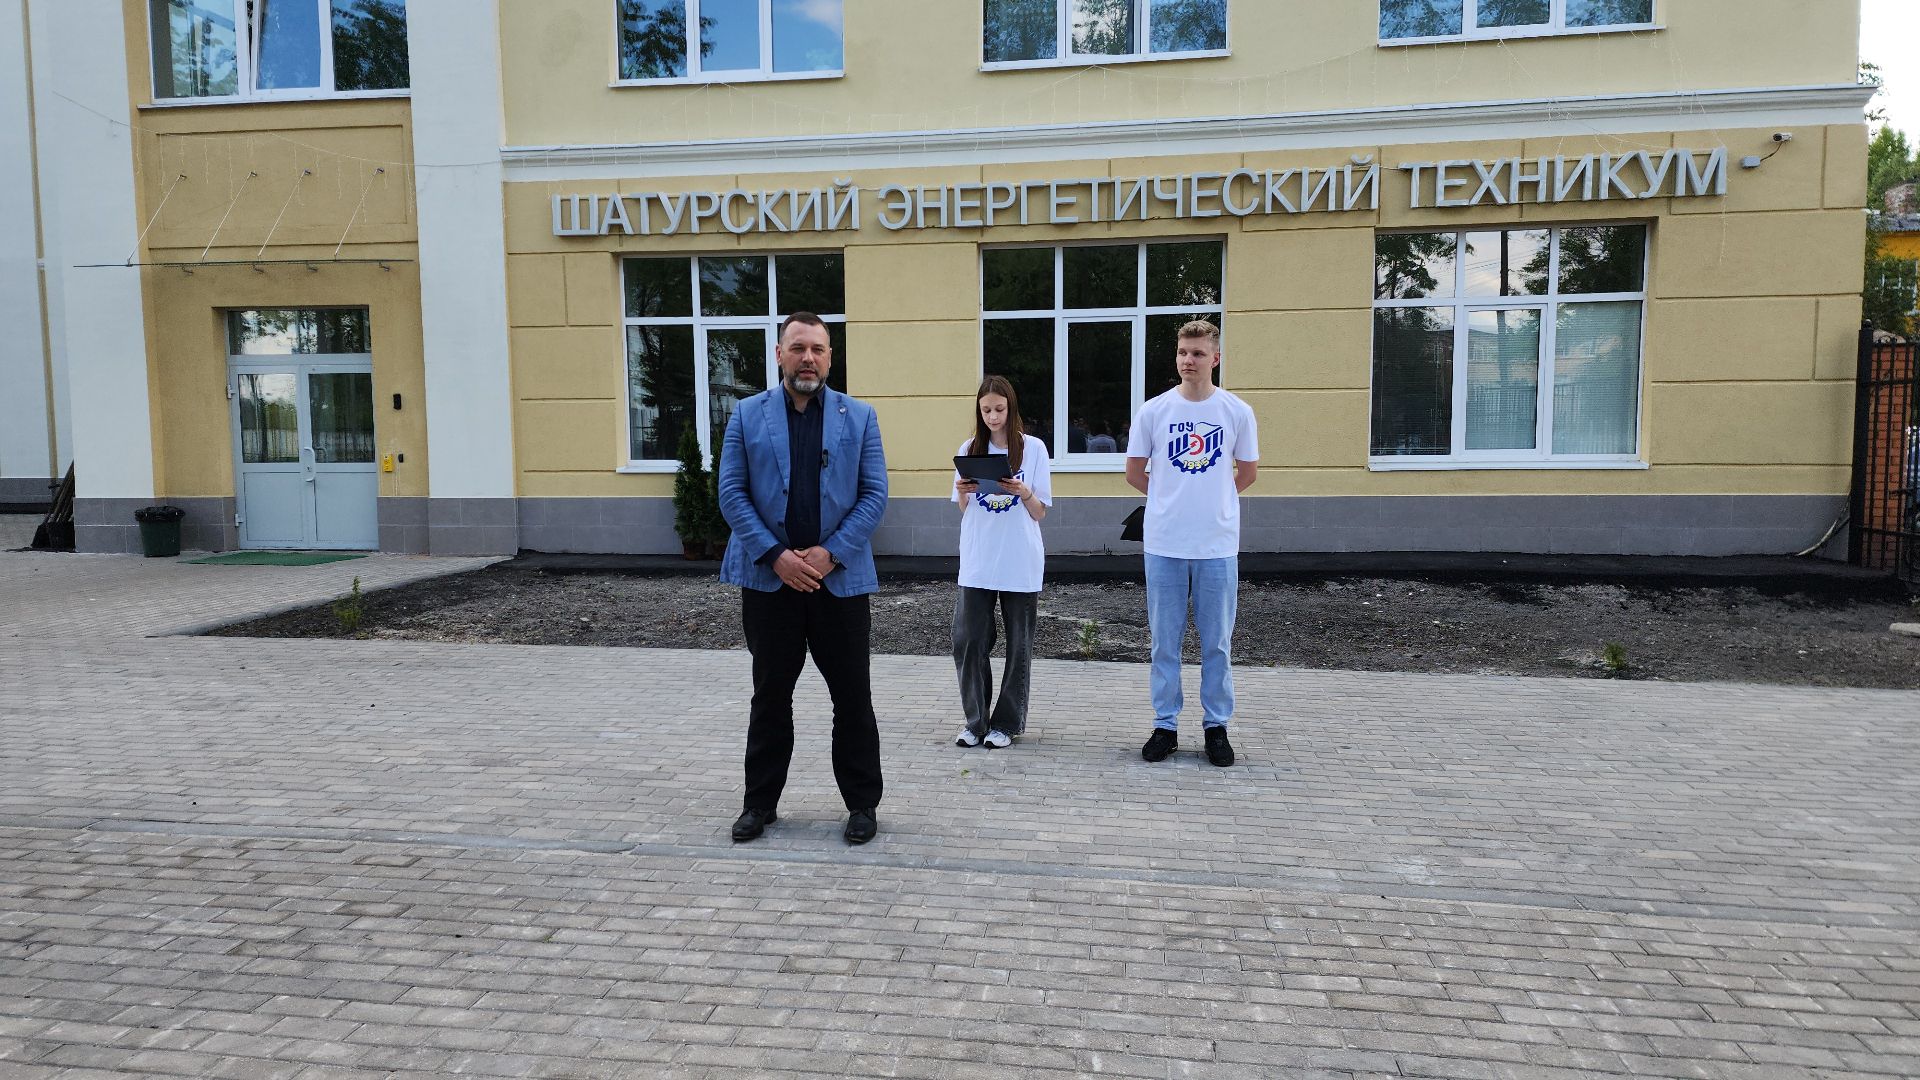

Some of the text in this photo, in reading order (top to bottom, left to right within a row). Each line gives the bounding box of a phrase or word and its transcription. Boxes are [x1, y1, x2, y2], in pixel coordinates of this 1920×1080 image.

[552, 147, 1728, 236] ШАТУРСКИЙ ЭНЕРГЕТИЧЕСКИЙ ТЕХНИКУМ
[1169, 422, 1194, 433] ГОУ
